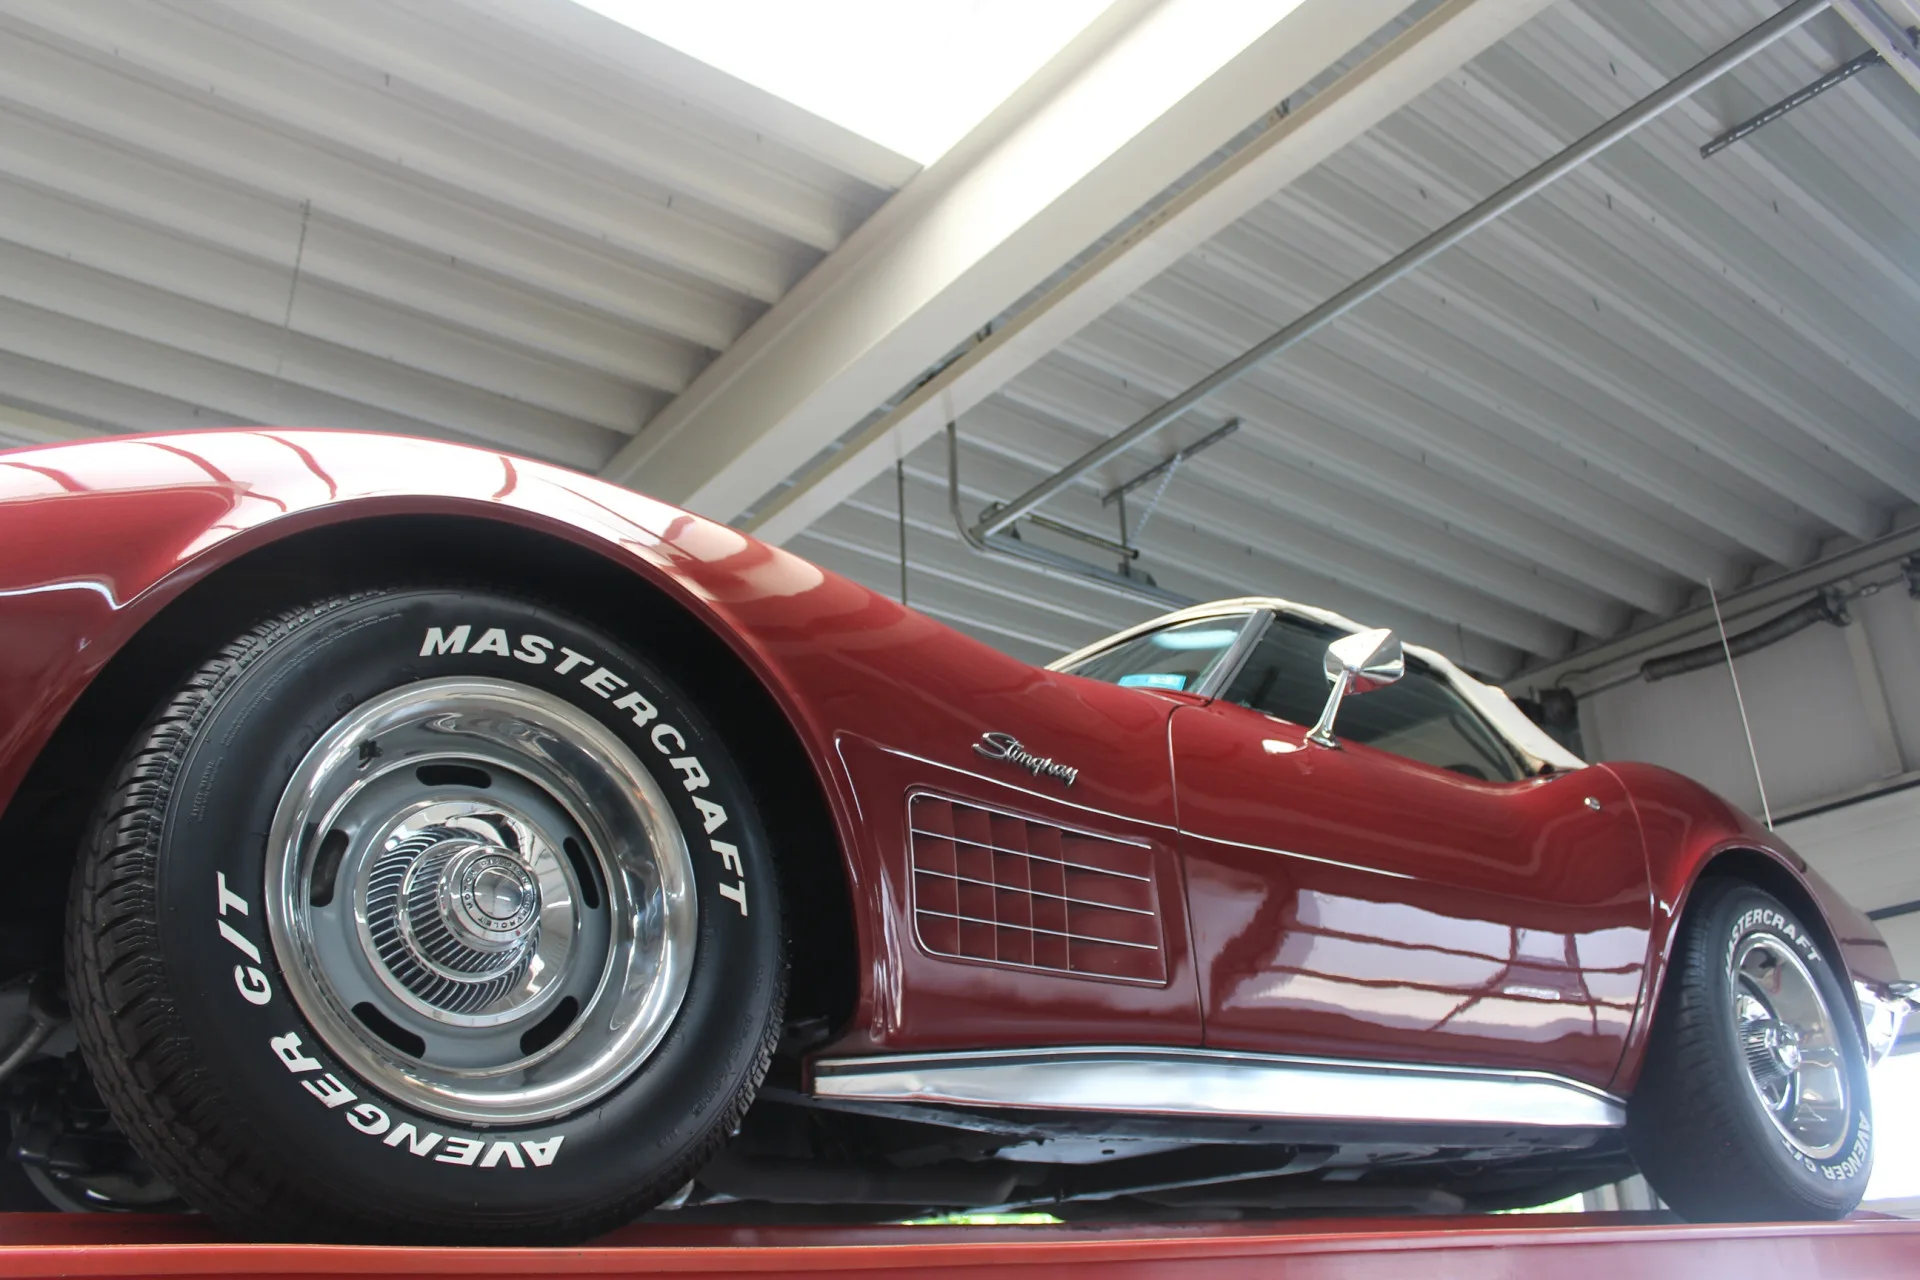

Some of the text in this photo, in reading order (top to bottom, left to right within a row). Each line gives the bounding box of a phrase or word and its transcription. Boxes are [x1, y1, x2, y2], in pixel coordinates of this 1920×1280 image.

[419, 625, 748, 916] MASTERCRAFT
[972, 732, 1079, 787] Stingray
[270, 1032, 565, 1168] AVENGER
[1821, 1110, 1870, 1180] AVENGER
